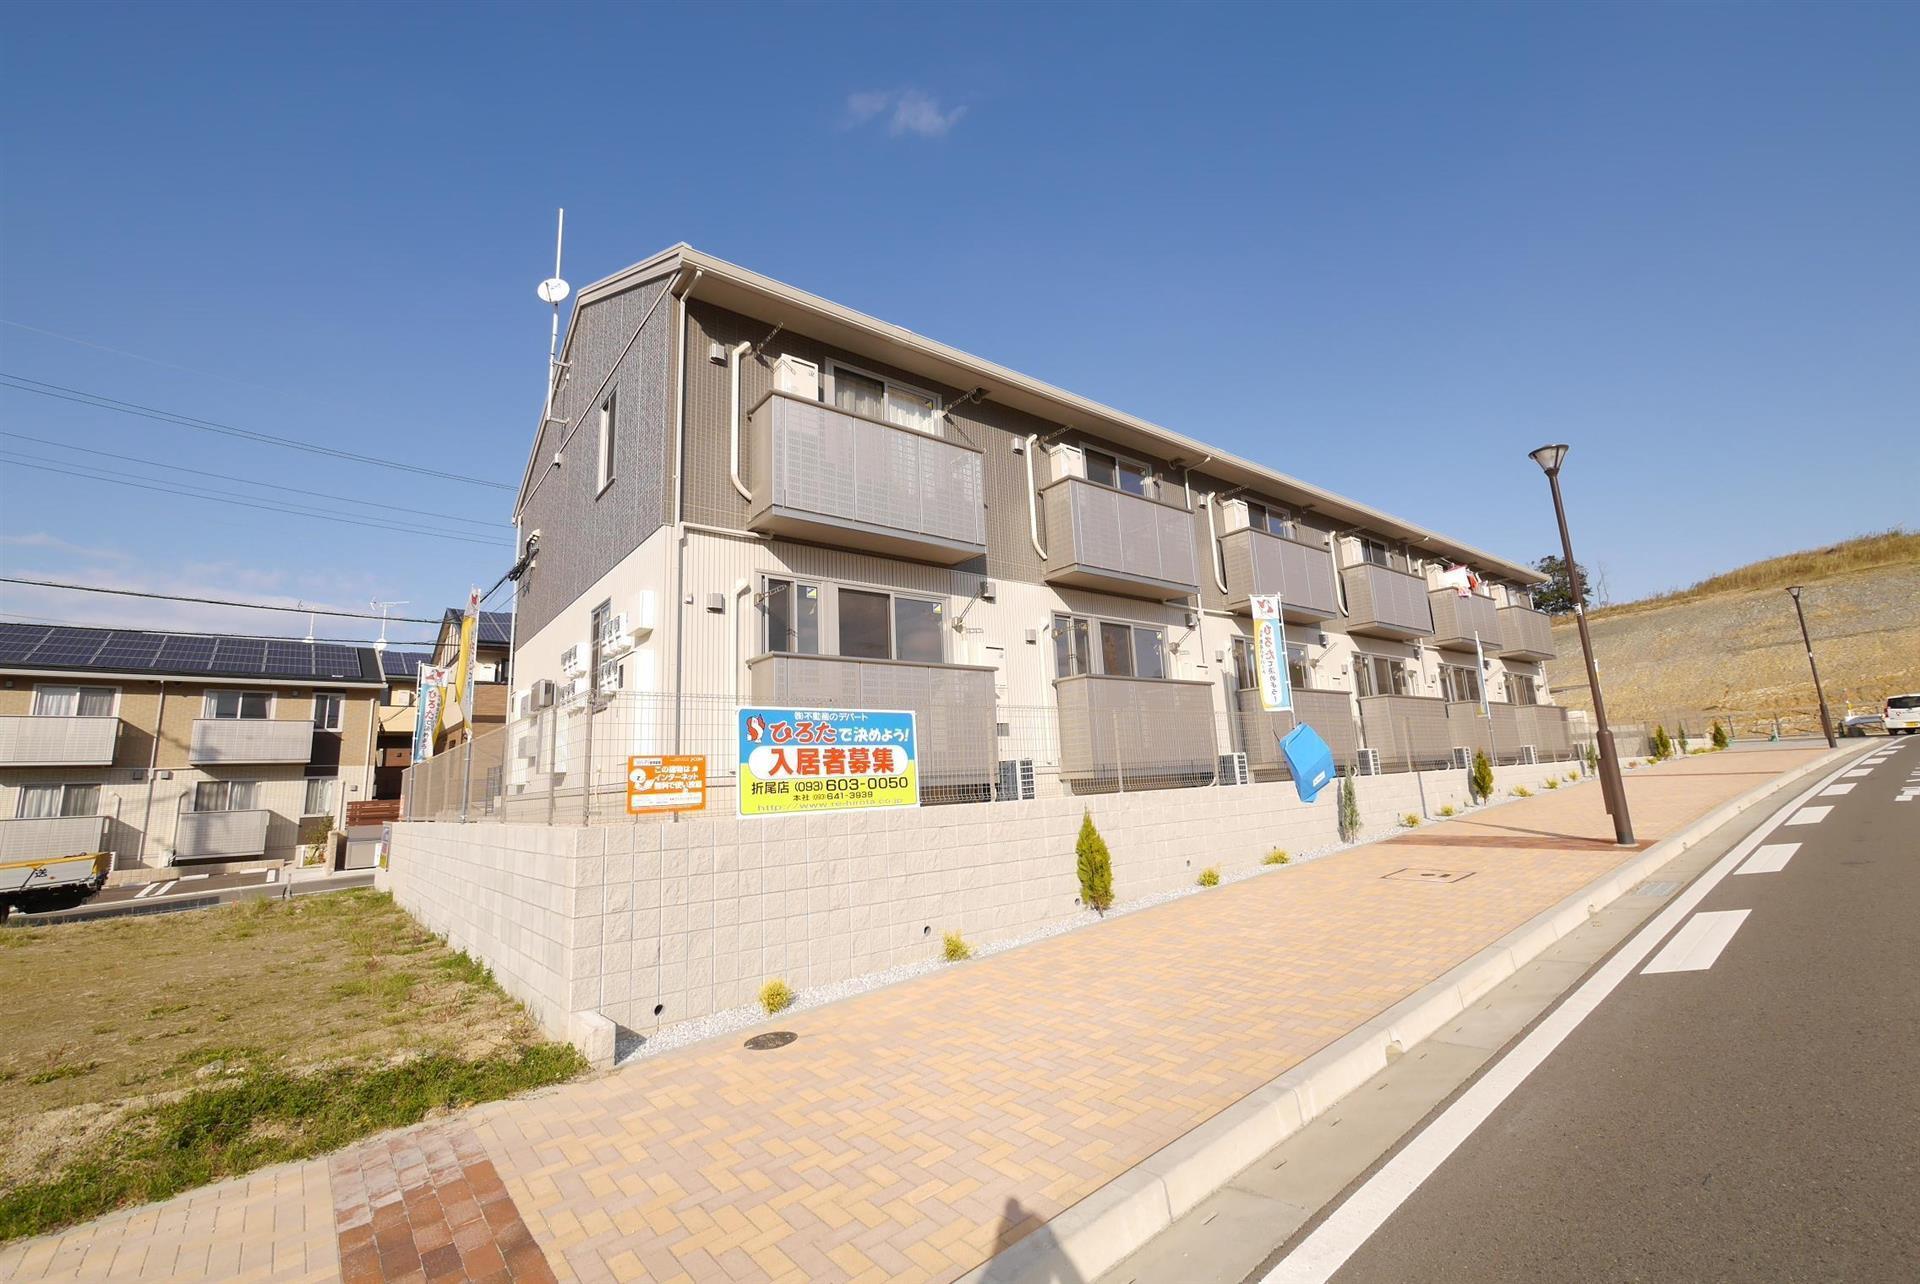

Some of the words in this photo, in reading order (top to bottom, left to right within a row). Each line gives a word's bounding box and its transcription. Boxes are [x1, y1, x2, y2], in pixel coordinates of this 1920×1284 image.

[768, 720, 909, 744] ひろたで決めよう!
[768, 748, 894, 776] 入居者募集
[751, 781, 790, 795] 折尾店
